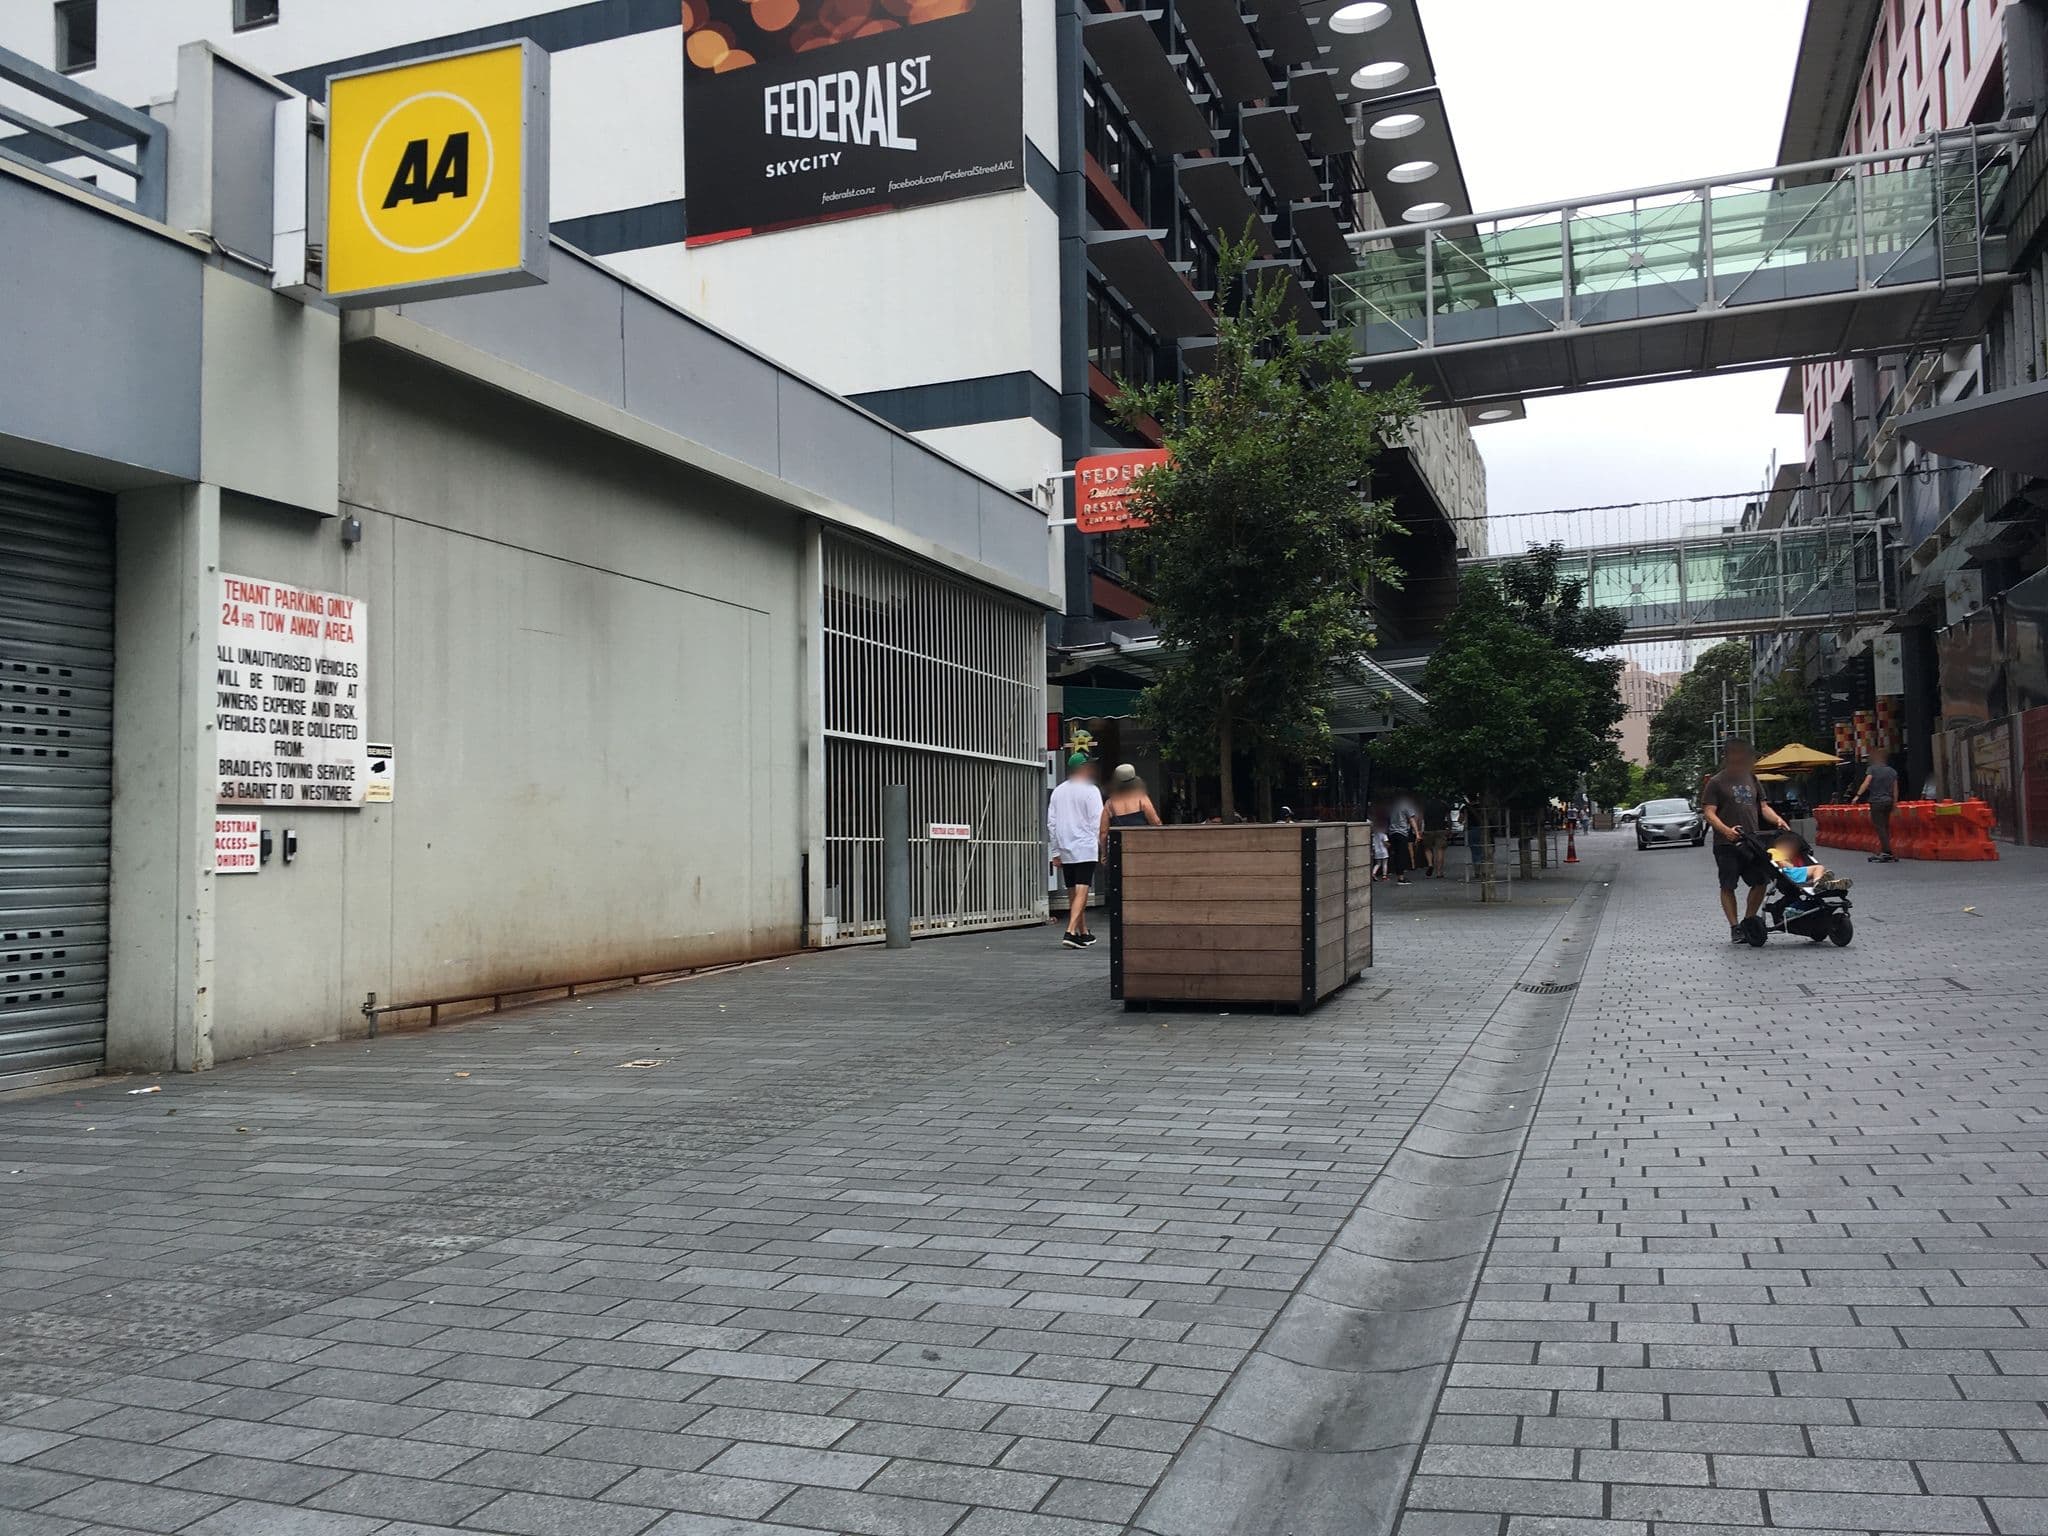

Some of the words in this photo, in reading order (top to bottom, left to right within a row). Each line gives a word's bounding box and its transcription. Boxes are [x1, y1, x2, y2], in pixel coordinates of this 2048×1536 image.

[764, 62, 917, 151] FEDERAL
[900, 55, 931, 95] ST
[381, 132, 469, 209] AA
[765, 151, 842, 178] SKYCITY
[821, 186, 876, 204] federalst.co.nz
[888, 160, 1015, 192] facebook.com/FederalStreetAKL
[224, 578, 271, 606] TENANT
[275, 588, 324, 615] PARKING
[327, 598, 353, 619] ONLY
[222, 603, 239, 626] 24
[242, 613, 254, 628] HR
[259, 611, 285, 633] TOW
[290, 616, 320, 638] AWAY
[324, 622, 354, 643] AREA
[238, 648, 311, 672] UNAUTHORISED
[315, 658, 358, 678] VEHICLES
[250, 673, 263, 689] BE
[272, 675, 306, 693] TOWED
[314, 680, 339, 696] AWAY
[347, 684, 358, 698] AT
[263, 696, 306, 715] EXPENSE
[312, 702, 330, 717] AND
[334, 703, 358, 720] RISK.
[217, 714, 266, 734] VEHICLES
[269, 718, 289, 735] CAN
[292, 721, 304, 736] BE
[307, 722, 358, 740] COLLECTED
[274, 740, 305, 757] FROM:
[219, 759, 273, 778] BRADLEYS
[276, 762, 313, 779] TOWING
[317, 765, 355, 781] SERVICE
[221, 782, 235, 798] 35
[238, 782, 277, 799] GARNET
[280, 784, 294, 799] RD
[301, 785, 352, 801] WESTMERE
[215, 821, 257, 832] DESTRIAN
[217, 855, 255, 866] OHIBITED
